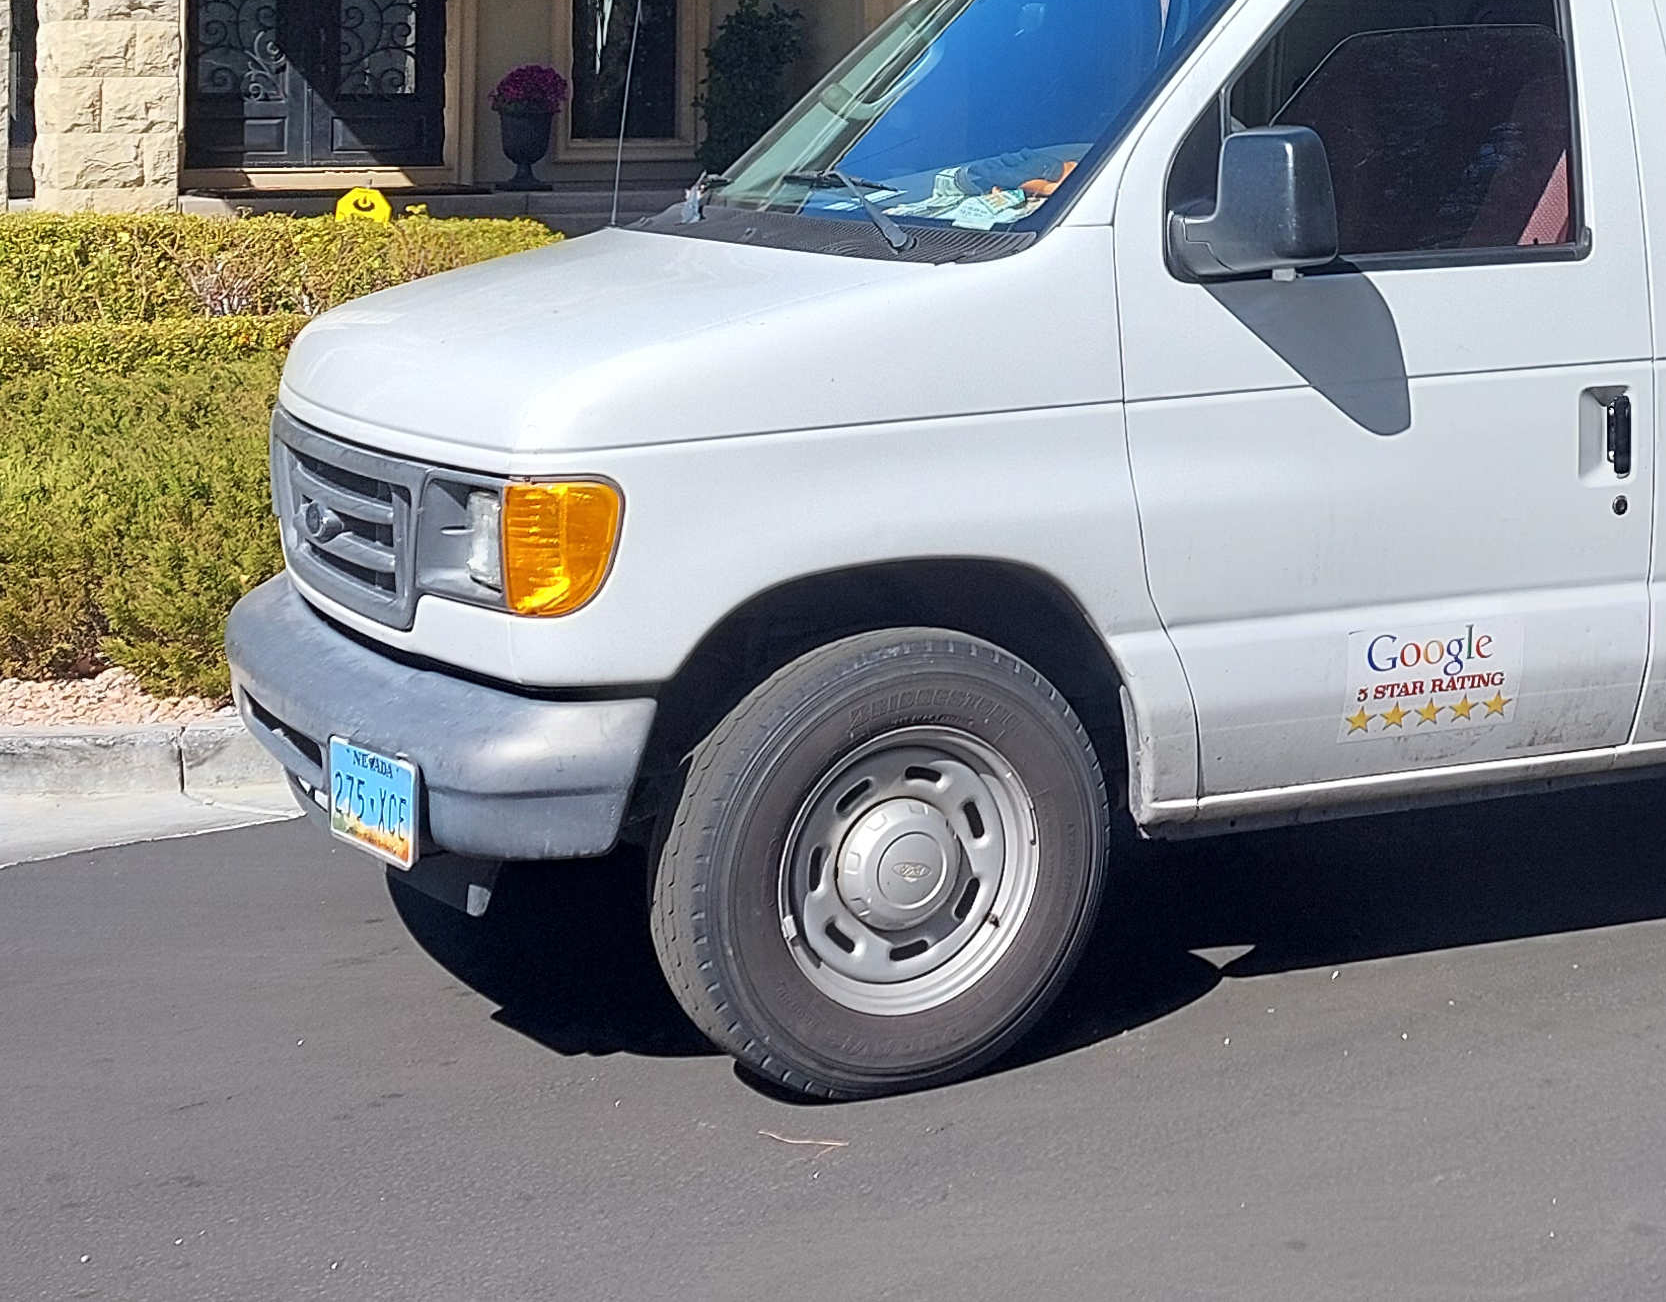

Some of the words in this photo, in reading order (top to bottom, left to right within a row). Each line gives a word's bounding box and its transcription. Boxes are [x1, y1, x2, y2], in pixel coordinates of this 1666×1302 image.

[1367, 624, 1493, 676] Google
[1357, 688, 1368, 702] 5
[1373, 680, 1425, 699] STAR
[1430, 672, 1505, 693] RATING
[353, 751, 393, 778] NEVADA
